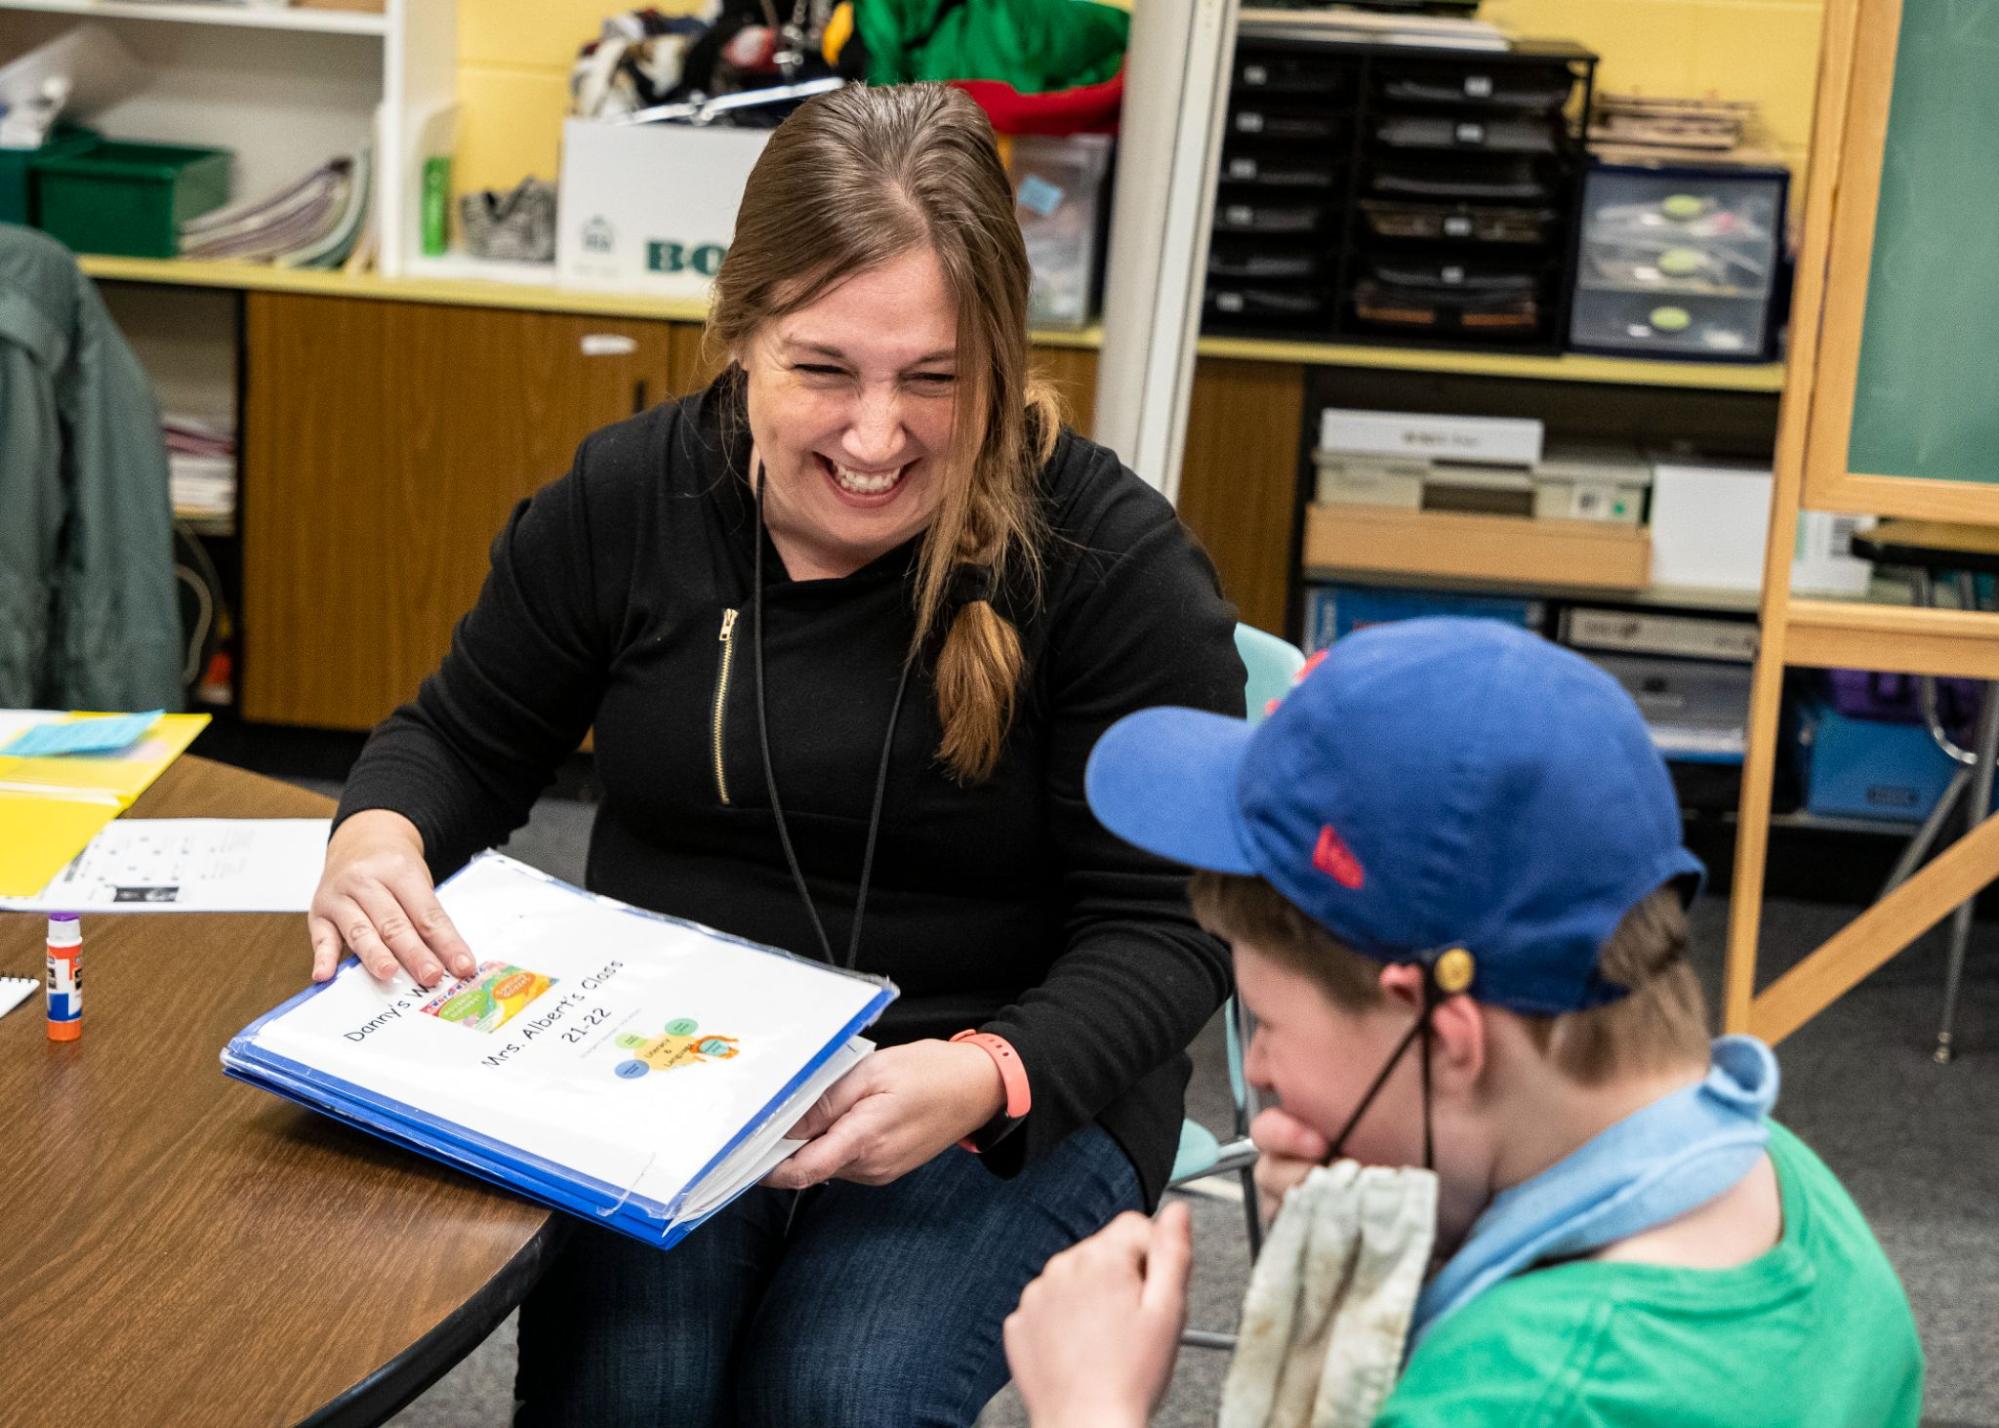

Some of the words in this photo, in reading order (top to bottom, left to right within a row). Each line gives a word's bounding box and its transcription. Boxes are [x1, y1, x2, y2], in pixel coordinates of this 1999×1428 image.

[647, 239, 729, 277] BO
[343, 999, 411, 1042] Danny's
[480, 1042, 526, 1069] Mrs.
[522, 992, 586, 1041] Albert's
[581, 959, 624, 991] Class
[561, 1006, 612, 1044] 21-22
